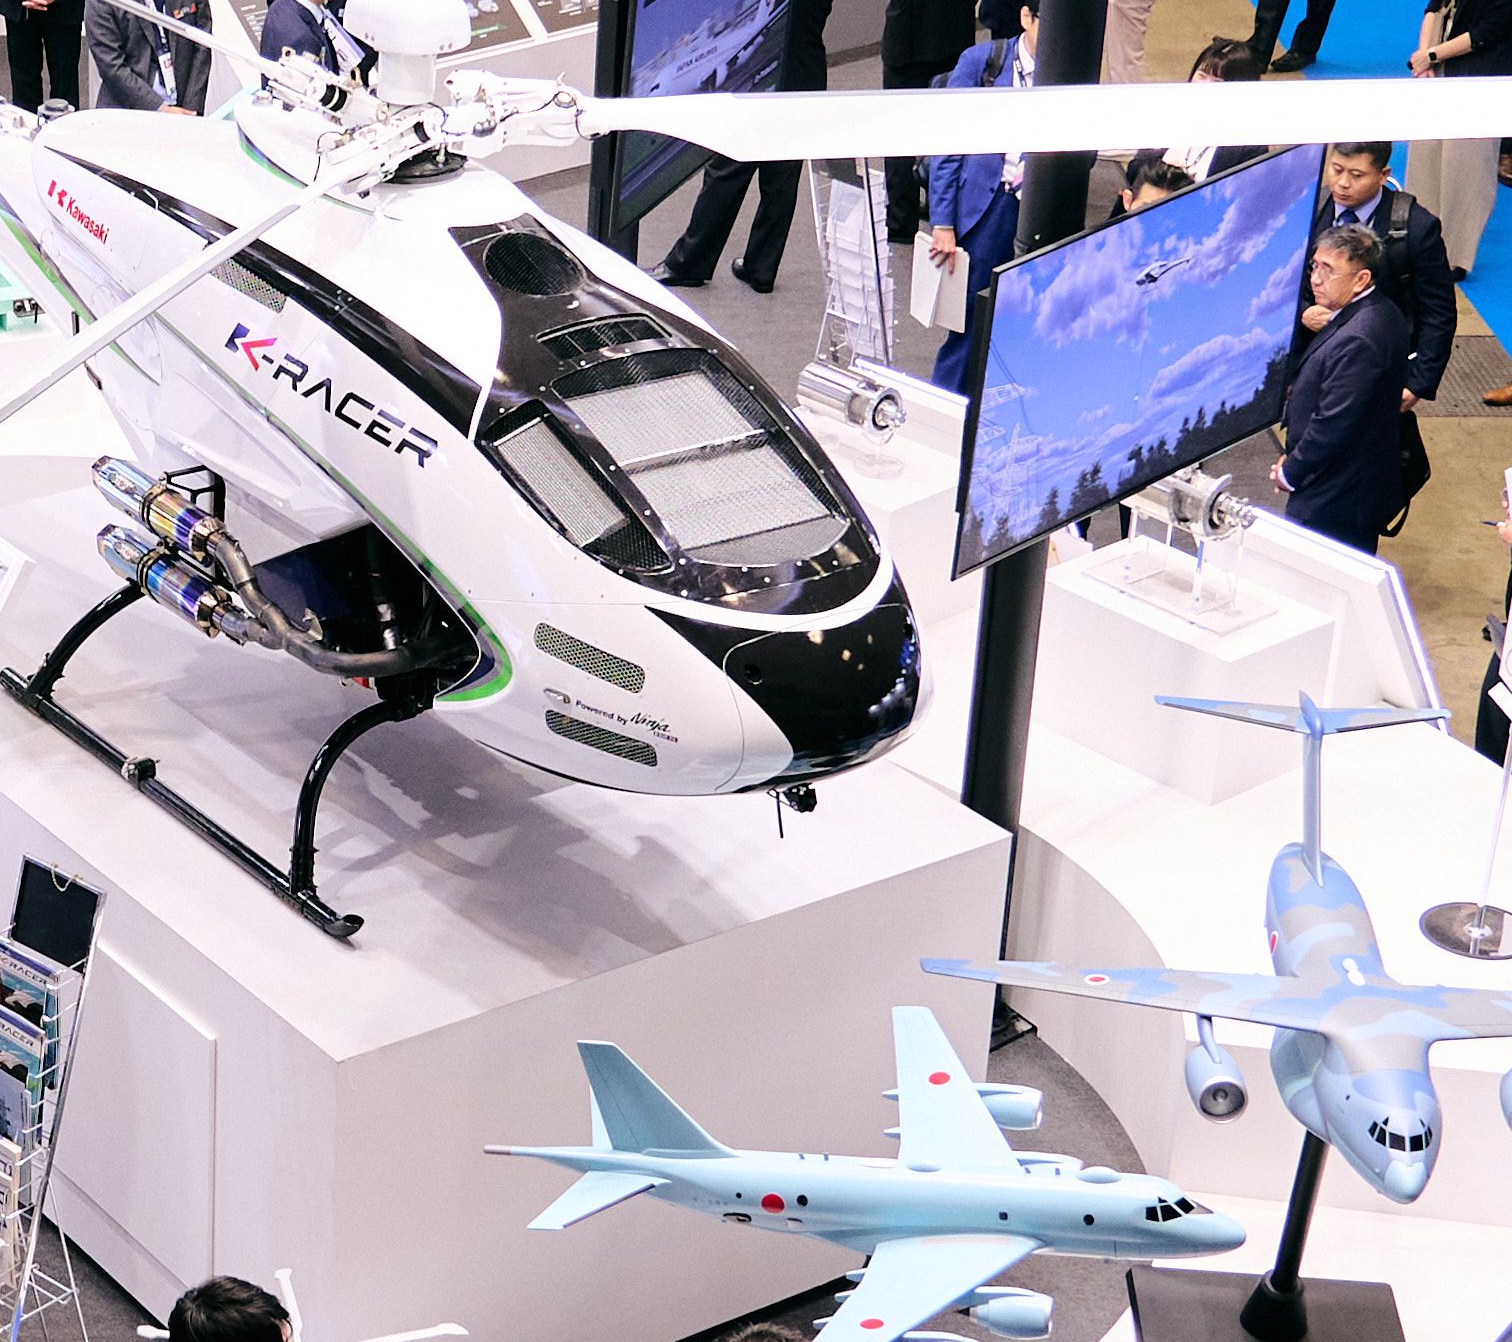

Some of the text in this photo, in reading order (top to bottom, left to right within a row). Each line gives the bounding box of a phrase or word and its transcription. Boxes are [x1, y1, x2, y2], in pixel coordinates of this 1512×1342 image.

[65, 196, 110, 245] Kawasaki
[225, 322, 439, 468] K-RACER
[575, 699, 672, 733] Powered by Ninja
